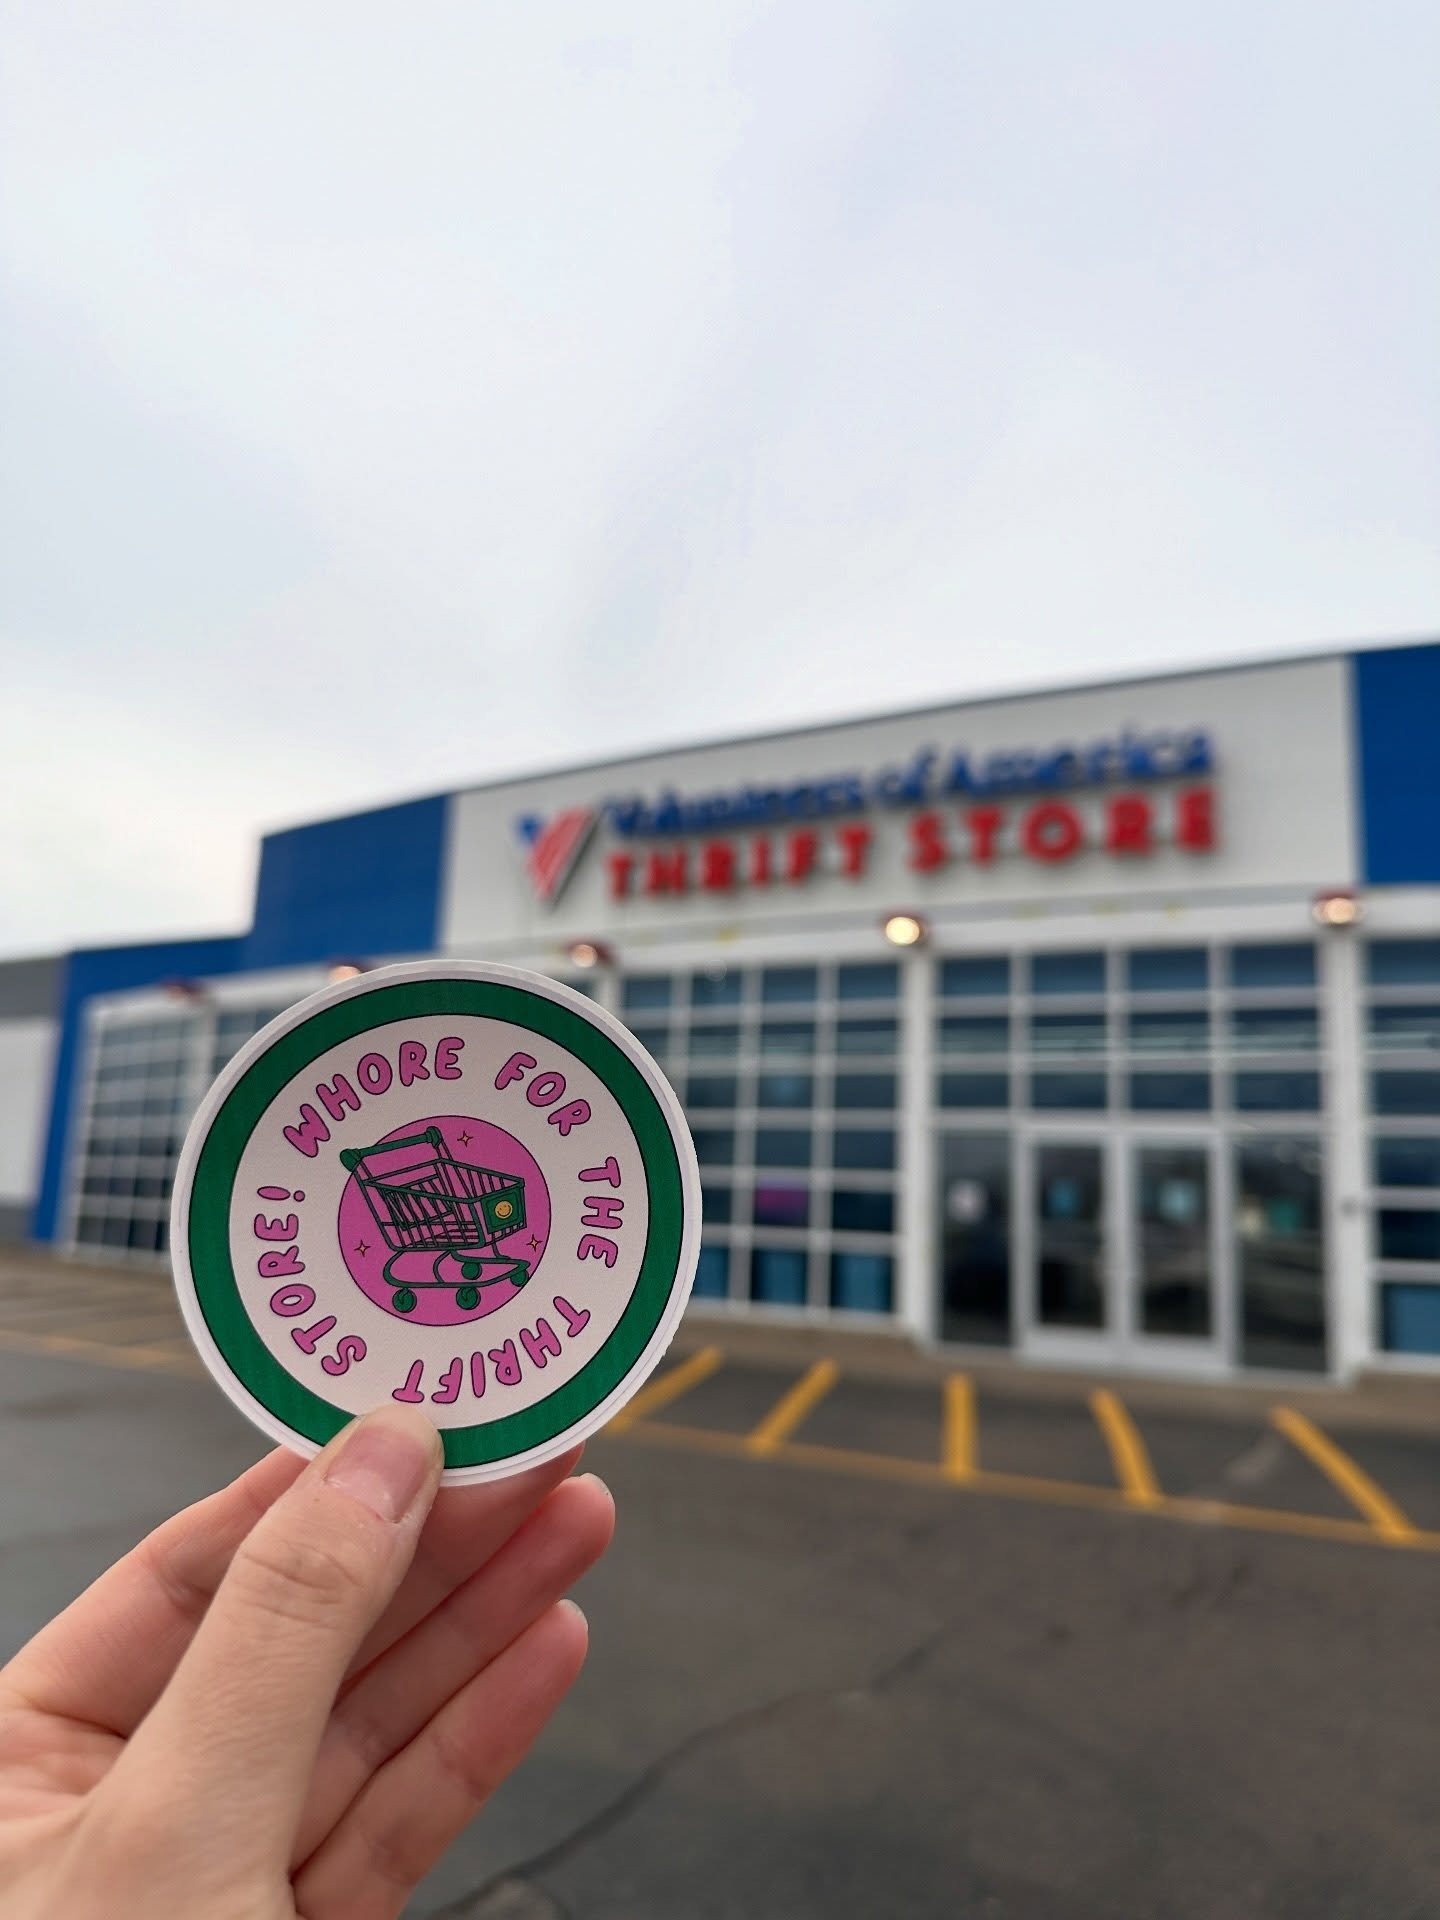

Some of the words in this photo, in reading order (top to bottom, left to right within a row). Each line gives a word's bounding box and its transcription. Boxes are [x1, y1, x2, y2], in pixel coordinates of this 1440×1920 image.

[606, 824, 874, 900] THRIFT
[907, 786, 1219, 871] STORE
[283, 1037, 465, 1158] WHORE
[494, 1052, 591, 1136] FOR
[577, 1156, 625, 1268] THE
[253, 1185, 368, 1377] STORE!
[391, 1296, 592, 1404] THRIFT
